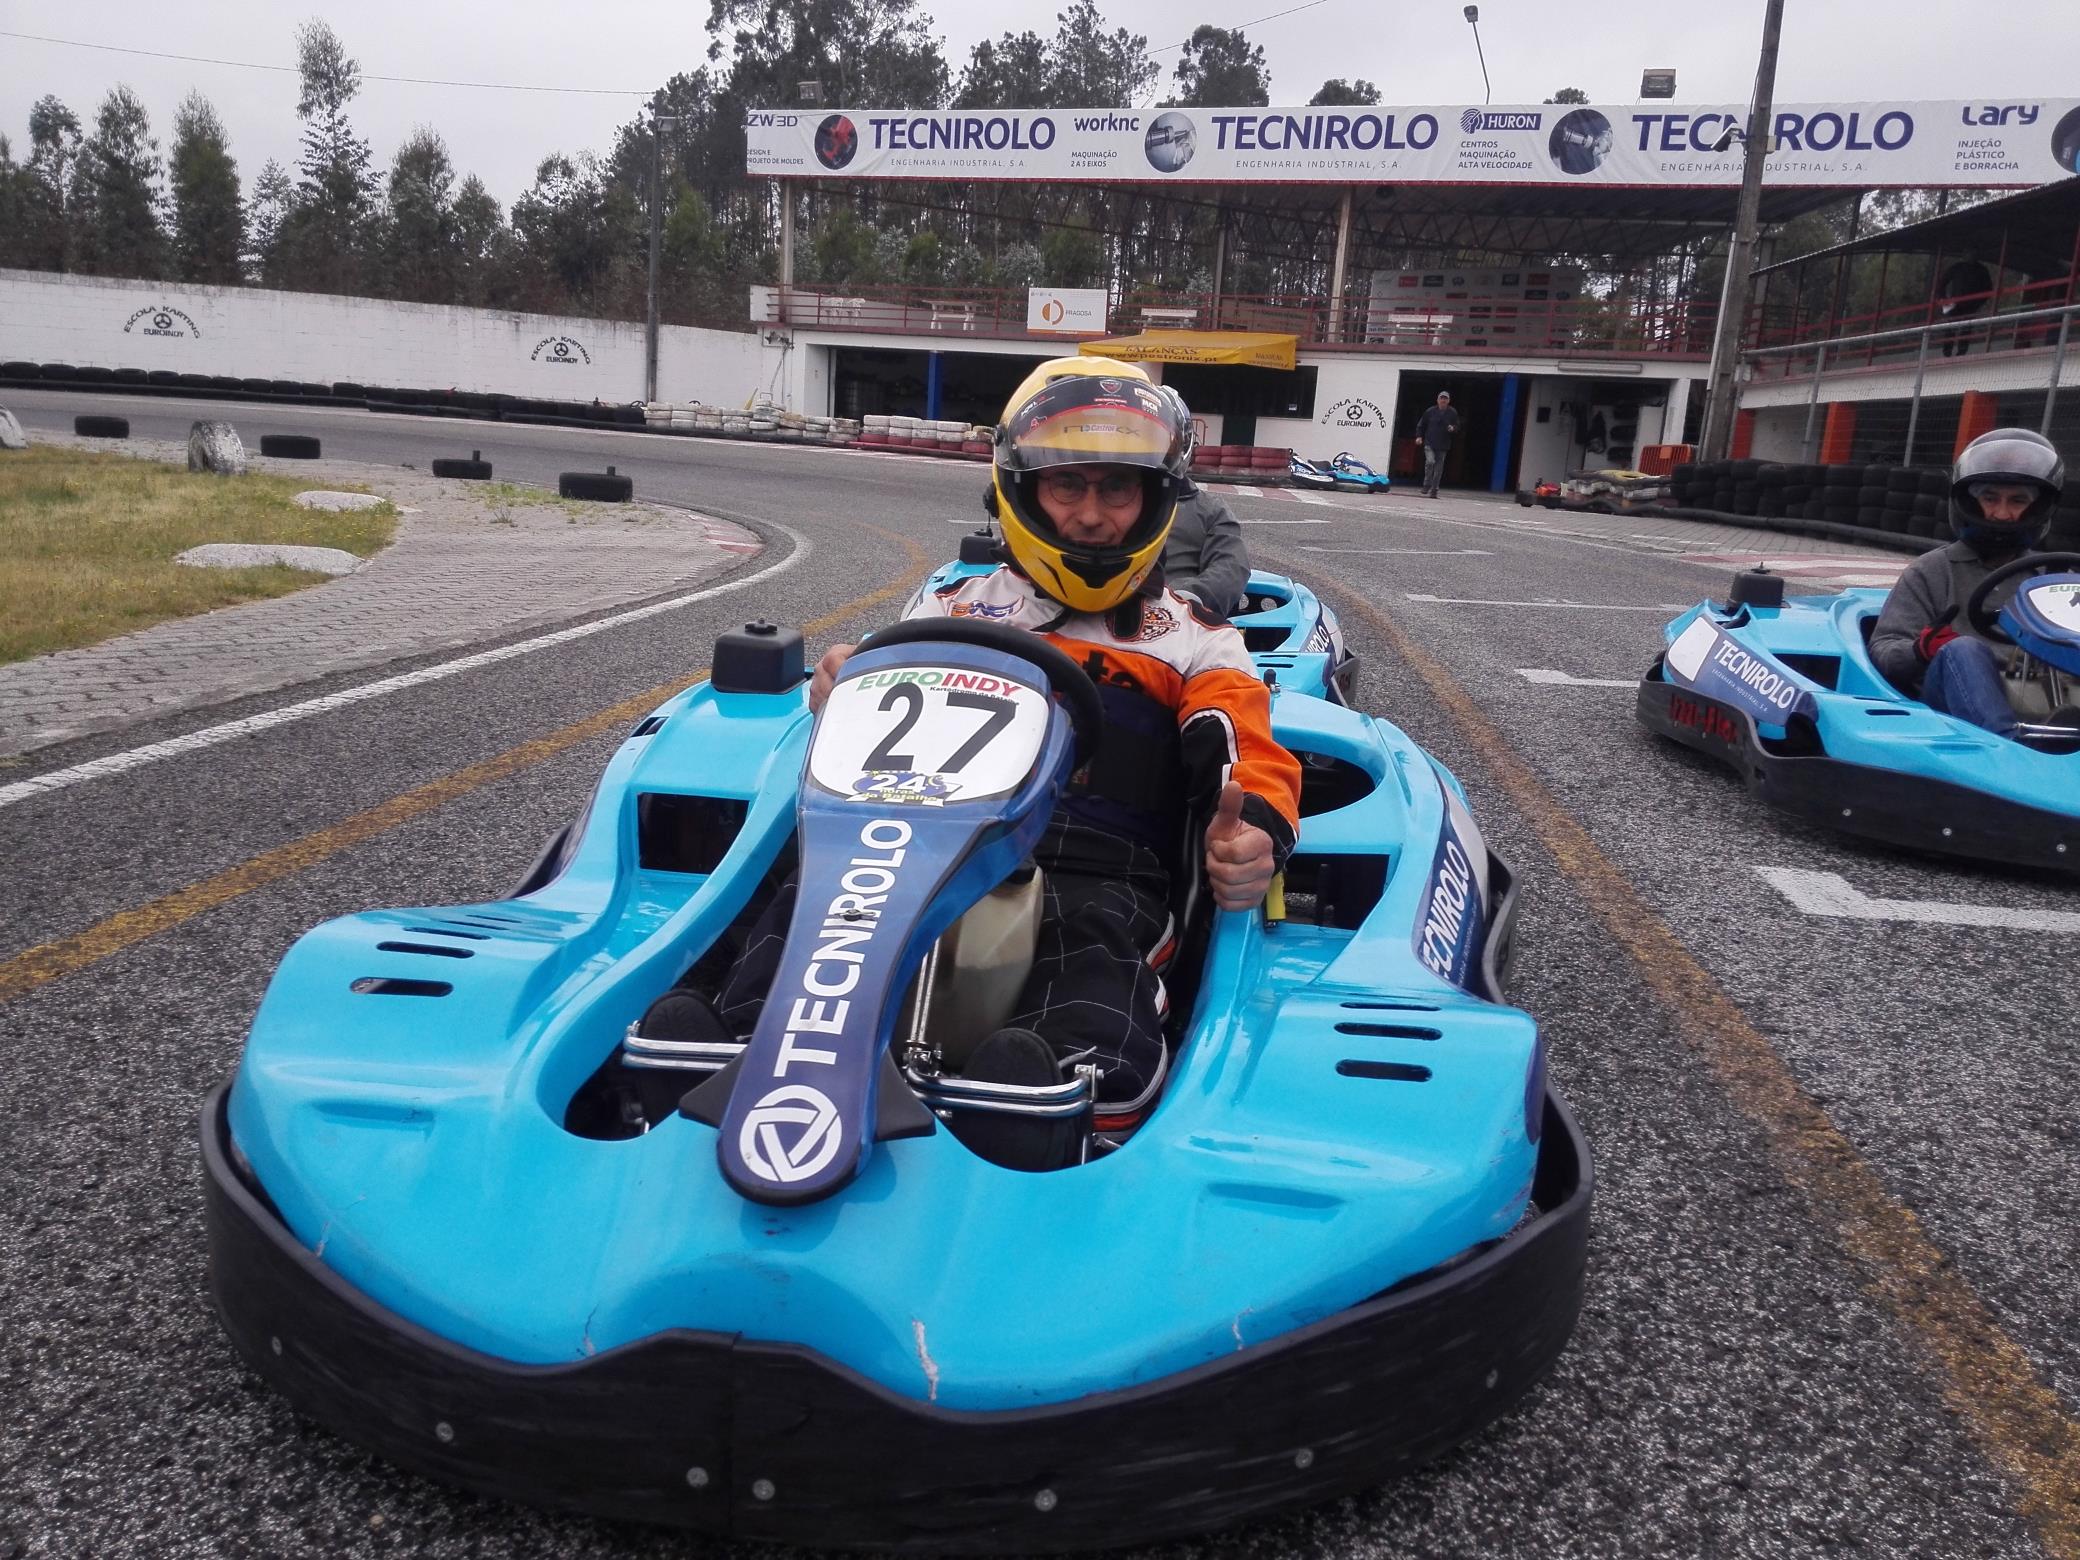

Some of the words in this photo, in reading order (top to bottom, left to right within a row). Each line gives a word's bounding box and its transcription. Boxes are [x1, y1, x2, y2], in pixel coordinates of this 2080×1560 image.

[747, 114, 798, 127] ZW3D
[1074, 112, 1140, 131] worknc
[1487, 115, 1537, 129] HURON
[869, 117, 1056, 150] TECNIROLO
[1211, 113, 1439, 150] TECNIROLO
[1632, 111, 1914, 151] TECNROLO
[1460, 141, 1498, 149] CENTROS
[1958, 138, 2002, 150] INJEÇÃO
[1071, 149, 1118, 159] MAQUINAÇÃO
[1459, 149, 1516, 160] MAQUINAÇÃO
[1956, 150, 2005, 159] PLÁSTICO
[890, 158, 946, 167] ENGENHARIA
[1087, 160, 1107, 168] EIXOS
[1236, 160, 1302, 168] ENGENHARIA
[1307, 160, 1376, 171] INDUSTRIAL,
[1458, 161, 1479, 169] ALTA
[1481, 161, 1533, 169] VELOCIDADE
[1661, 162, 1743, 172] ENGENHARIA
[1765, 162, 1834, 173] DUSTRIAL,
[1954, 162, 1961, 170] E
[1963, 162, 2019, 170] BORRACHA
[124, 306, 157, 333] ESCOLA
[162, 305, 201, 339] KARTING
[143, 328, 184, 338] EUROINDY
[531, 336, 556, 361] ESCOLA
[560, 336, 591, 364] KARTING
[545, 356, 578, 364] EUROINDY
[1321, 398, 1351, 425] ESCOLA
[1356, 398, 1386, 428] KARTING
[1336, 419, 1373, 428] EUROINDY
[1713, 639, 1795, 709] TECNIROLO
[856, 671, 1022, 697] EUROINDY
[861, 681, 1018, 774] 27
[867, 774, 926, 793] 24
[773, 819, 912, 1078] TECNIROLO
